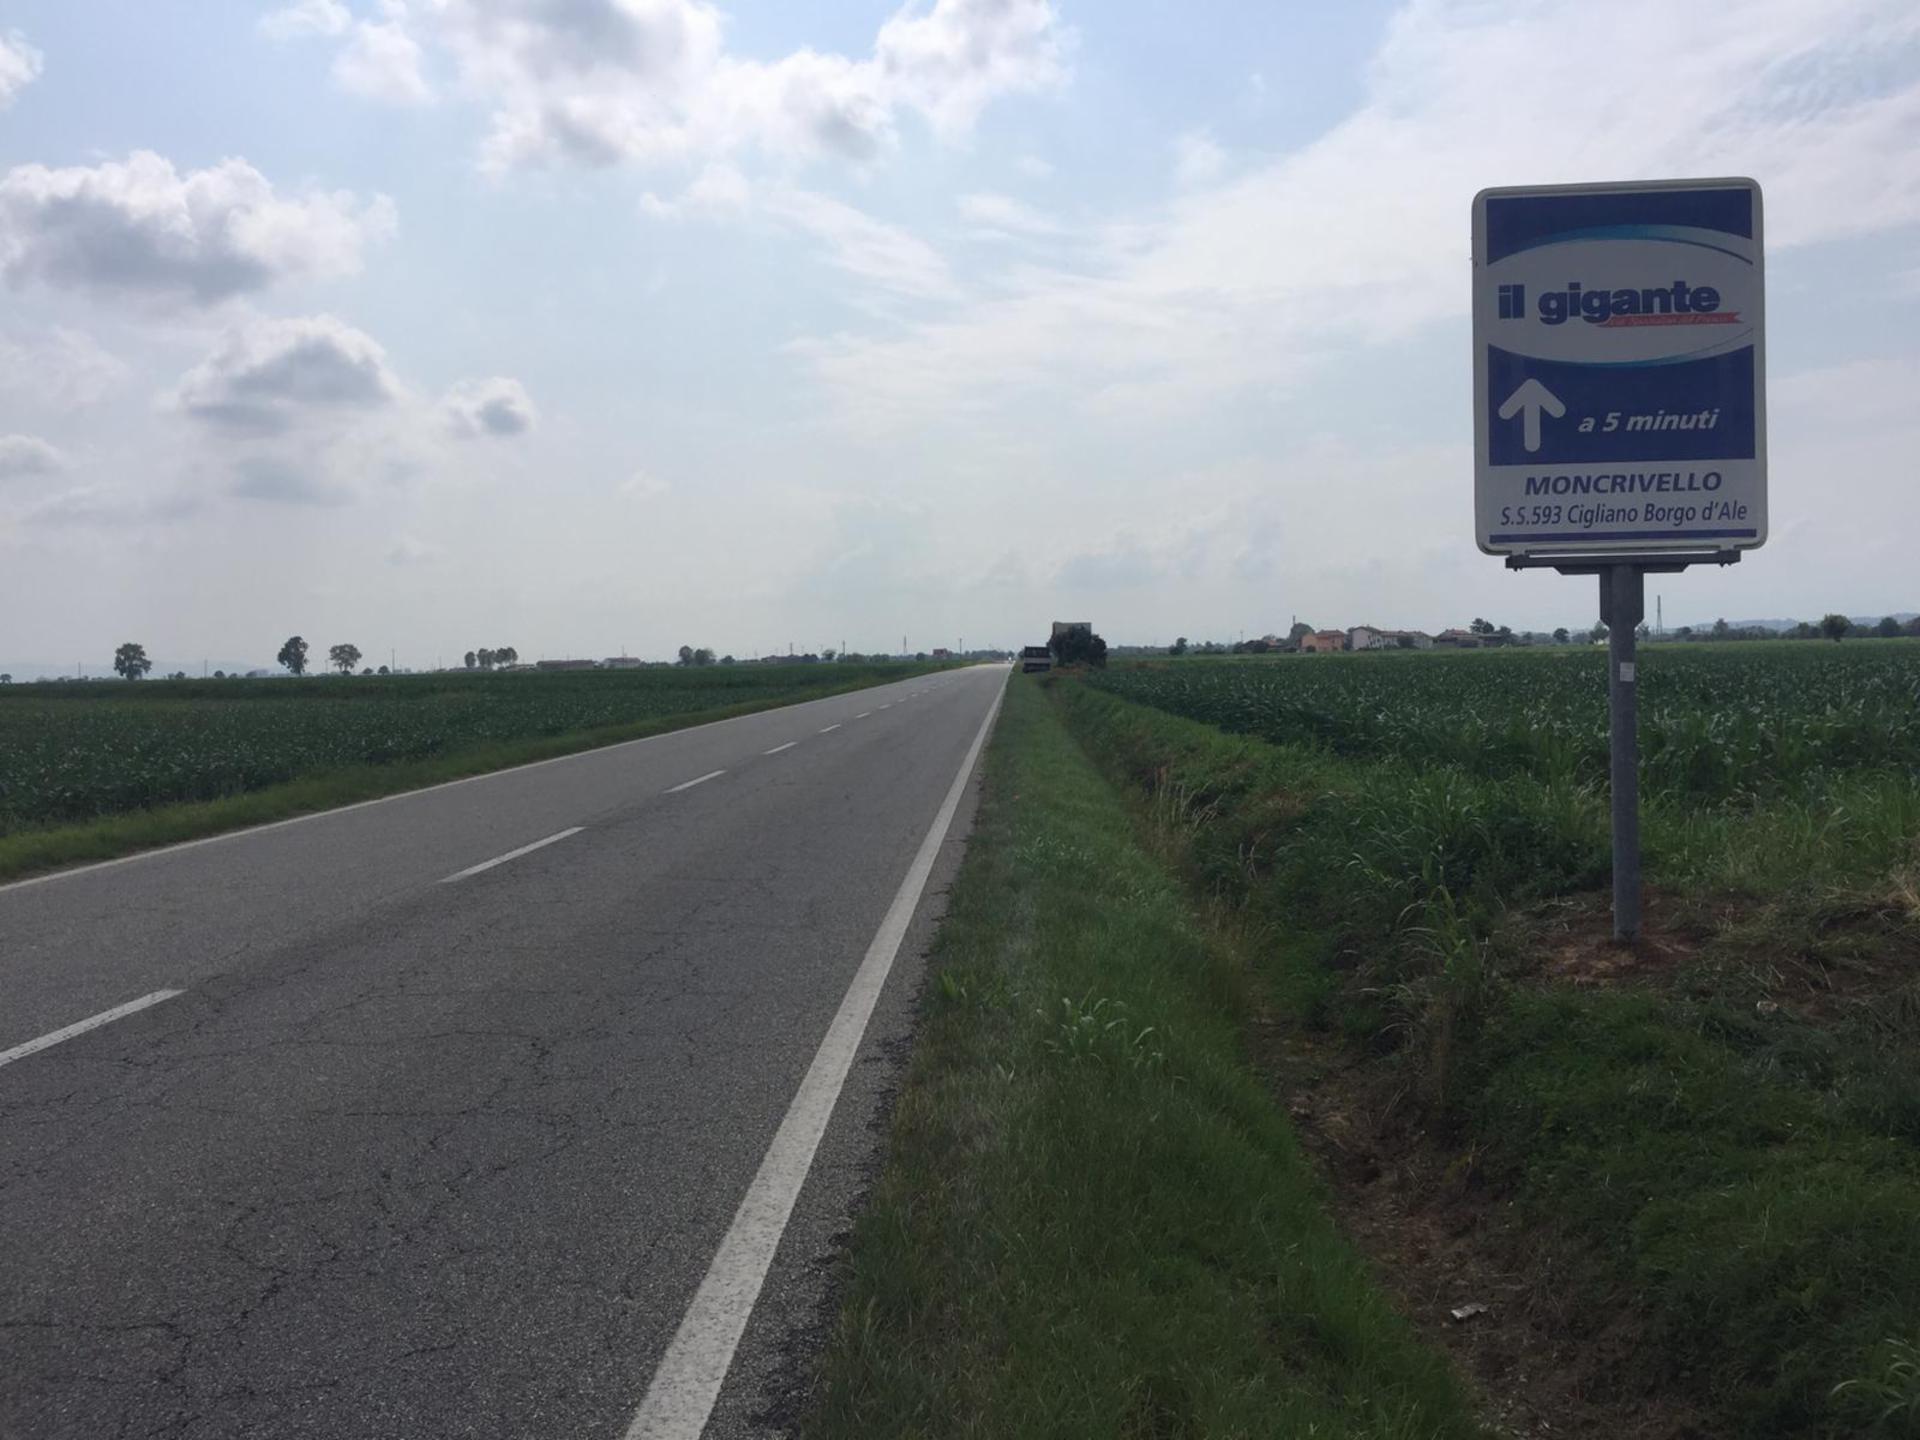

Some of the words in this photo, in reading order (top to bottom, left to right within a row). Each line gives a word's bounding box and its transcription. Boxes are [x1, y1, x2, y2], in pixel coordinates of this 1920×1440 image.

[1498, 284, 1525, 319] il
[1538, 281, 1721, 325] gigante
[1578, 417, 1594, 433] a
[1602, 412, 1621, 432] 5
[1626, 408, 1721, 432] minuti
[1524, 471, 1722, 496] MONCRIVELLO
[1501, 505, 1562, 526] S.S.593
[1567, 503, 1638, 529] Cigliano
[1644, 502, 1697, 527] Borgo
[1702, 500, 1747, 522] d'Ale
